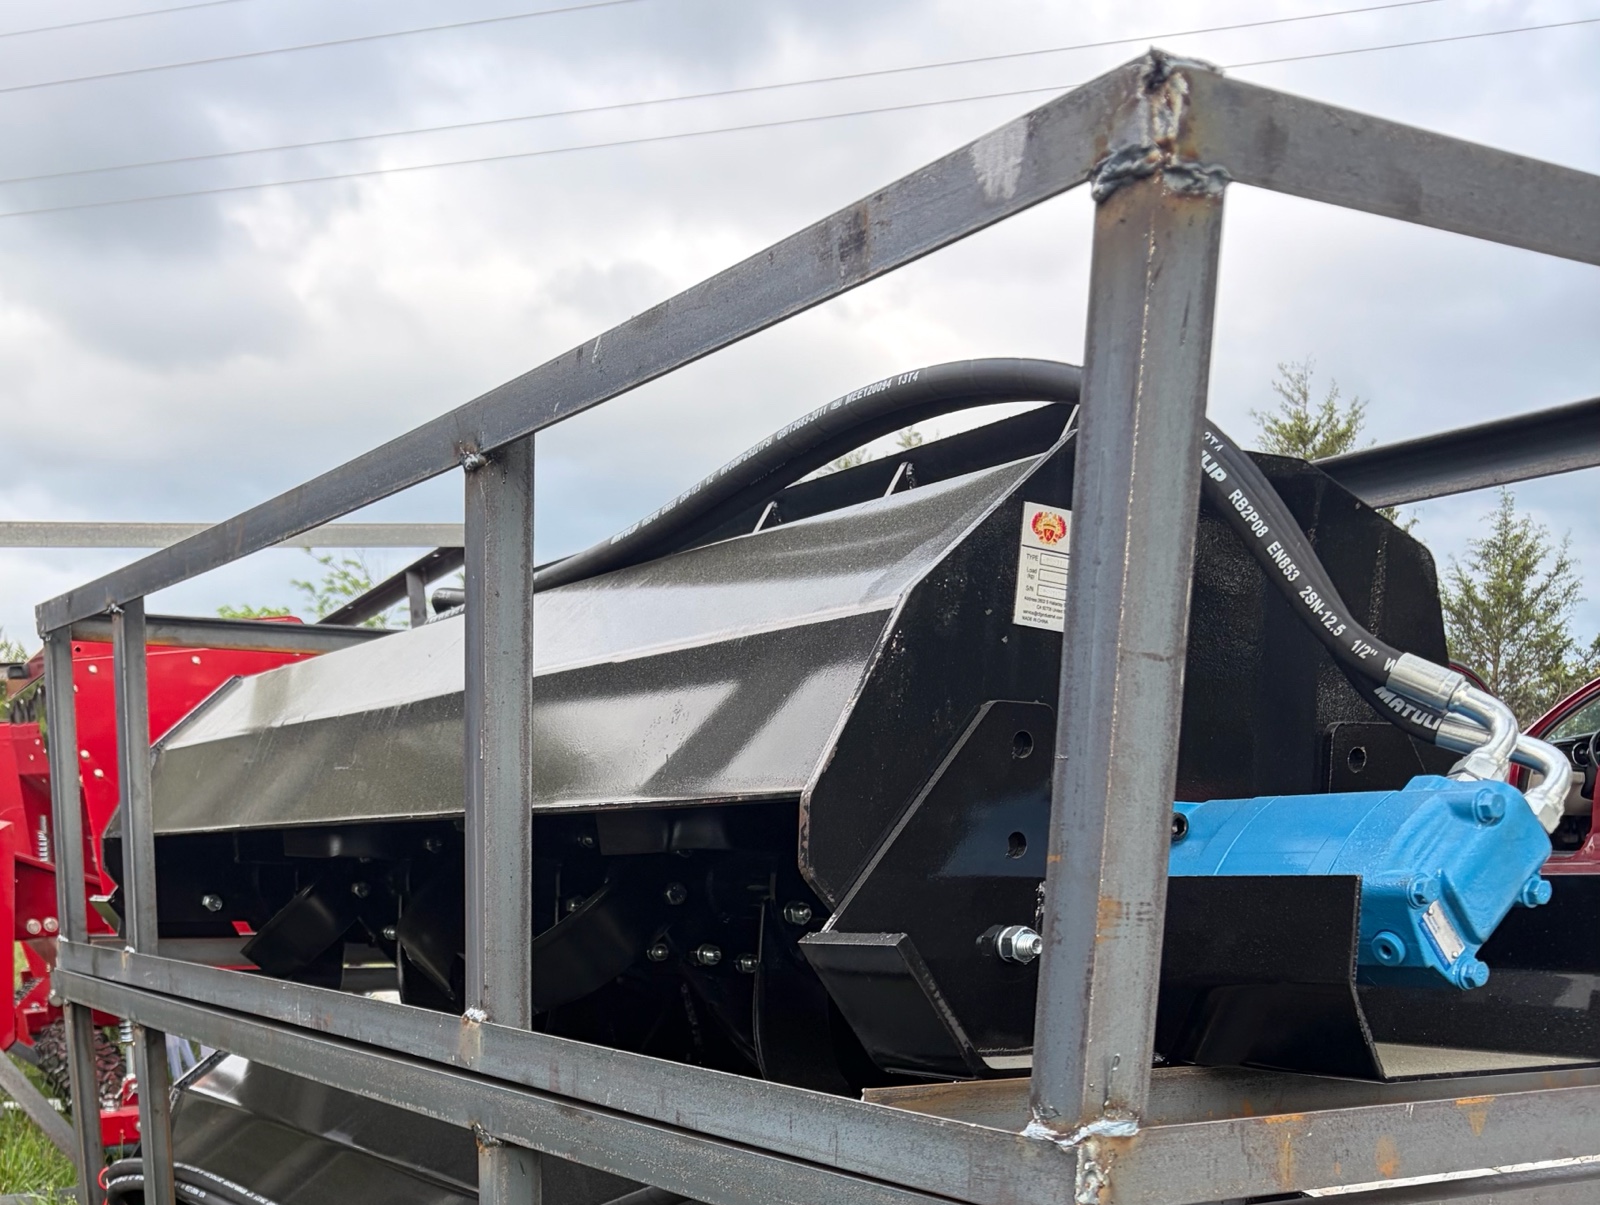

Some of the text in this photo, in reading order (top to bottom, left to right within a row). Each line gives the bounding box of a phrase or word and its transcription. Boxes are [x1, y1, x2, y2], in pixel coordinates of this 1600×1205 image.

[897, 370, 920, 386] 13T4
[1201, 449, 1227, 482] LIP
[1228, 488, 1269, 538] RB2P08
[1266, 540, 1300, 581] EN853
[1298, 585, 1347, 637] 2SN-12.5
[1026, 553, 1039, 561] TYPE
